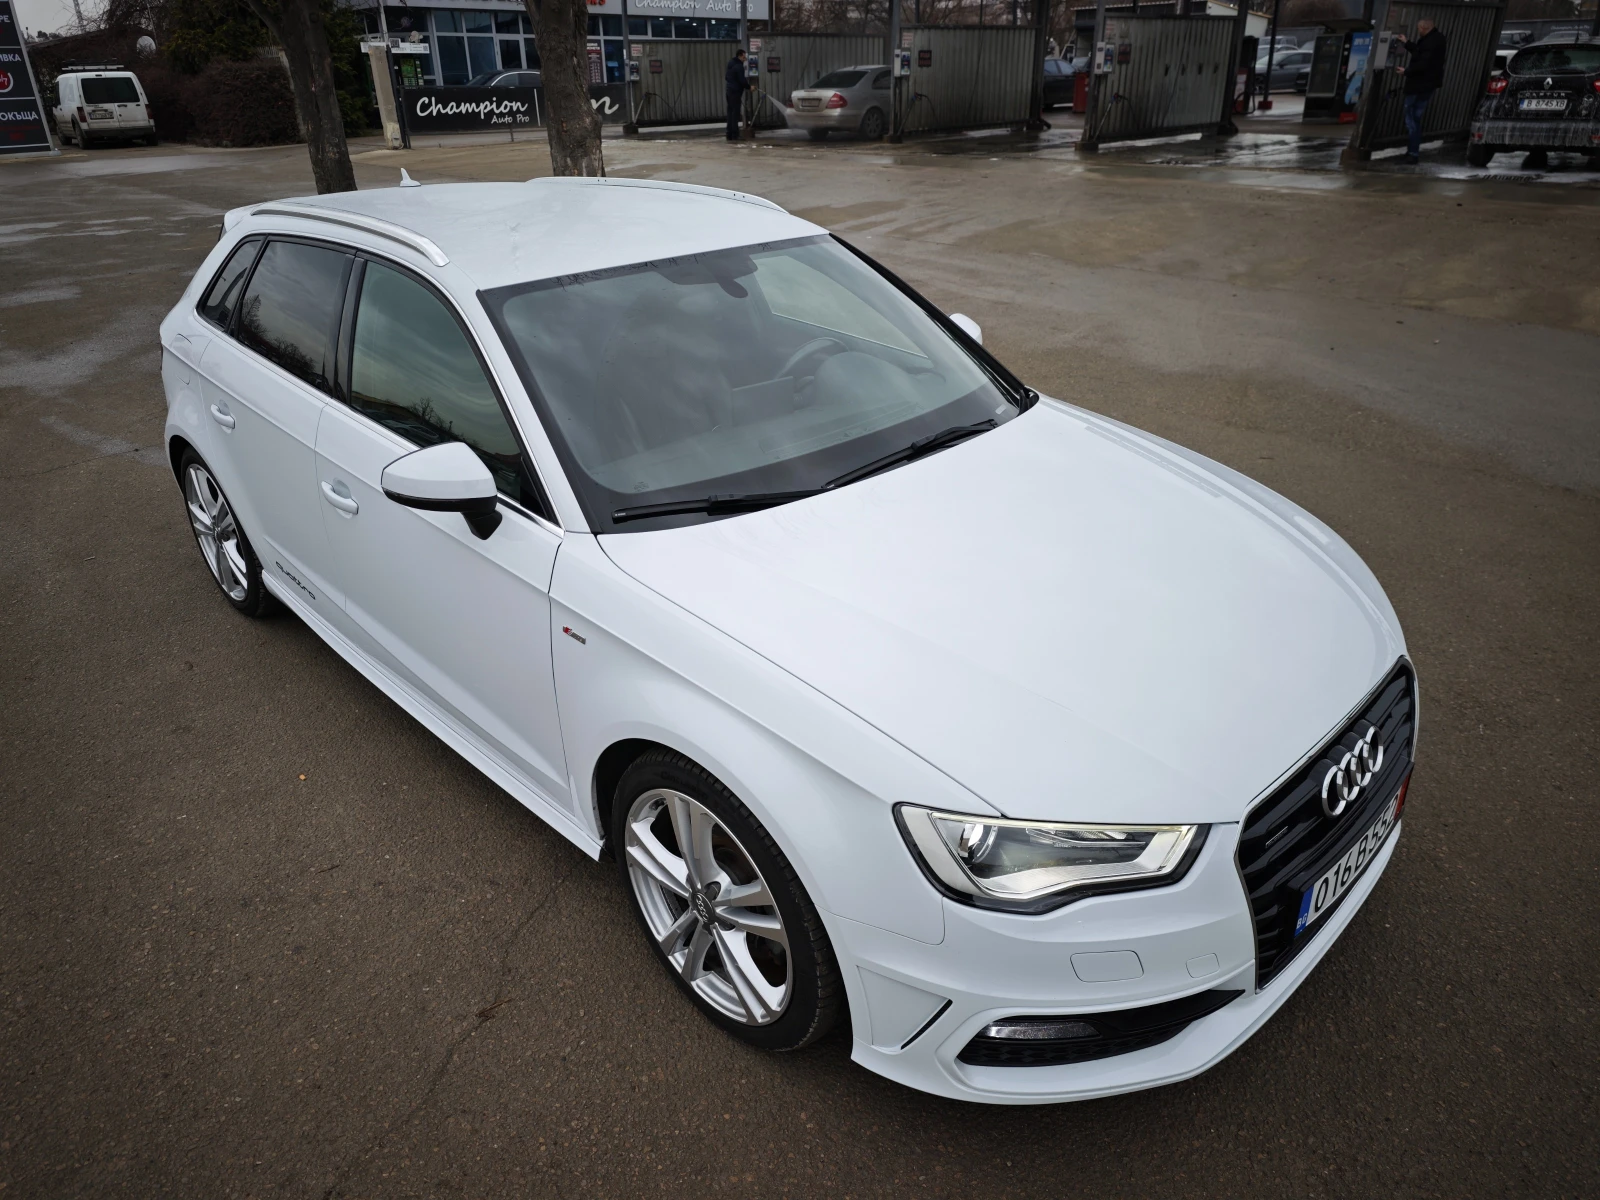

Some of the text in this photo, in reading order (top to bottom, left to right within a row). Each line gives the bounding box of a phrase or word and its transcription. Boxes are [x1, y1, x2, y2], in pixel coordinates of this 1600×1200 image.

[705, 0, 732, 12] Auto
[735, 0, 754, 12] Po
[416, 96, 528, 120] Champion
[491, 114, 530, 124] Auto Pro
[1296, 913, 1308, 928] BG
